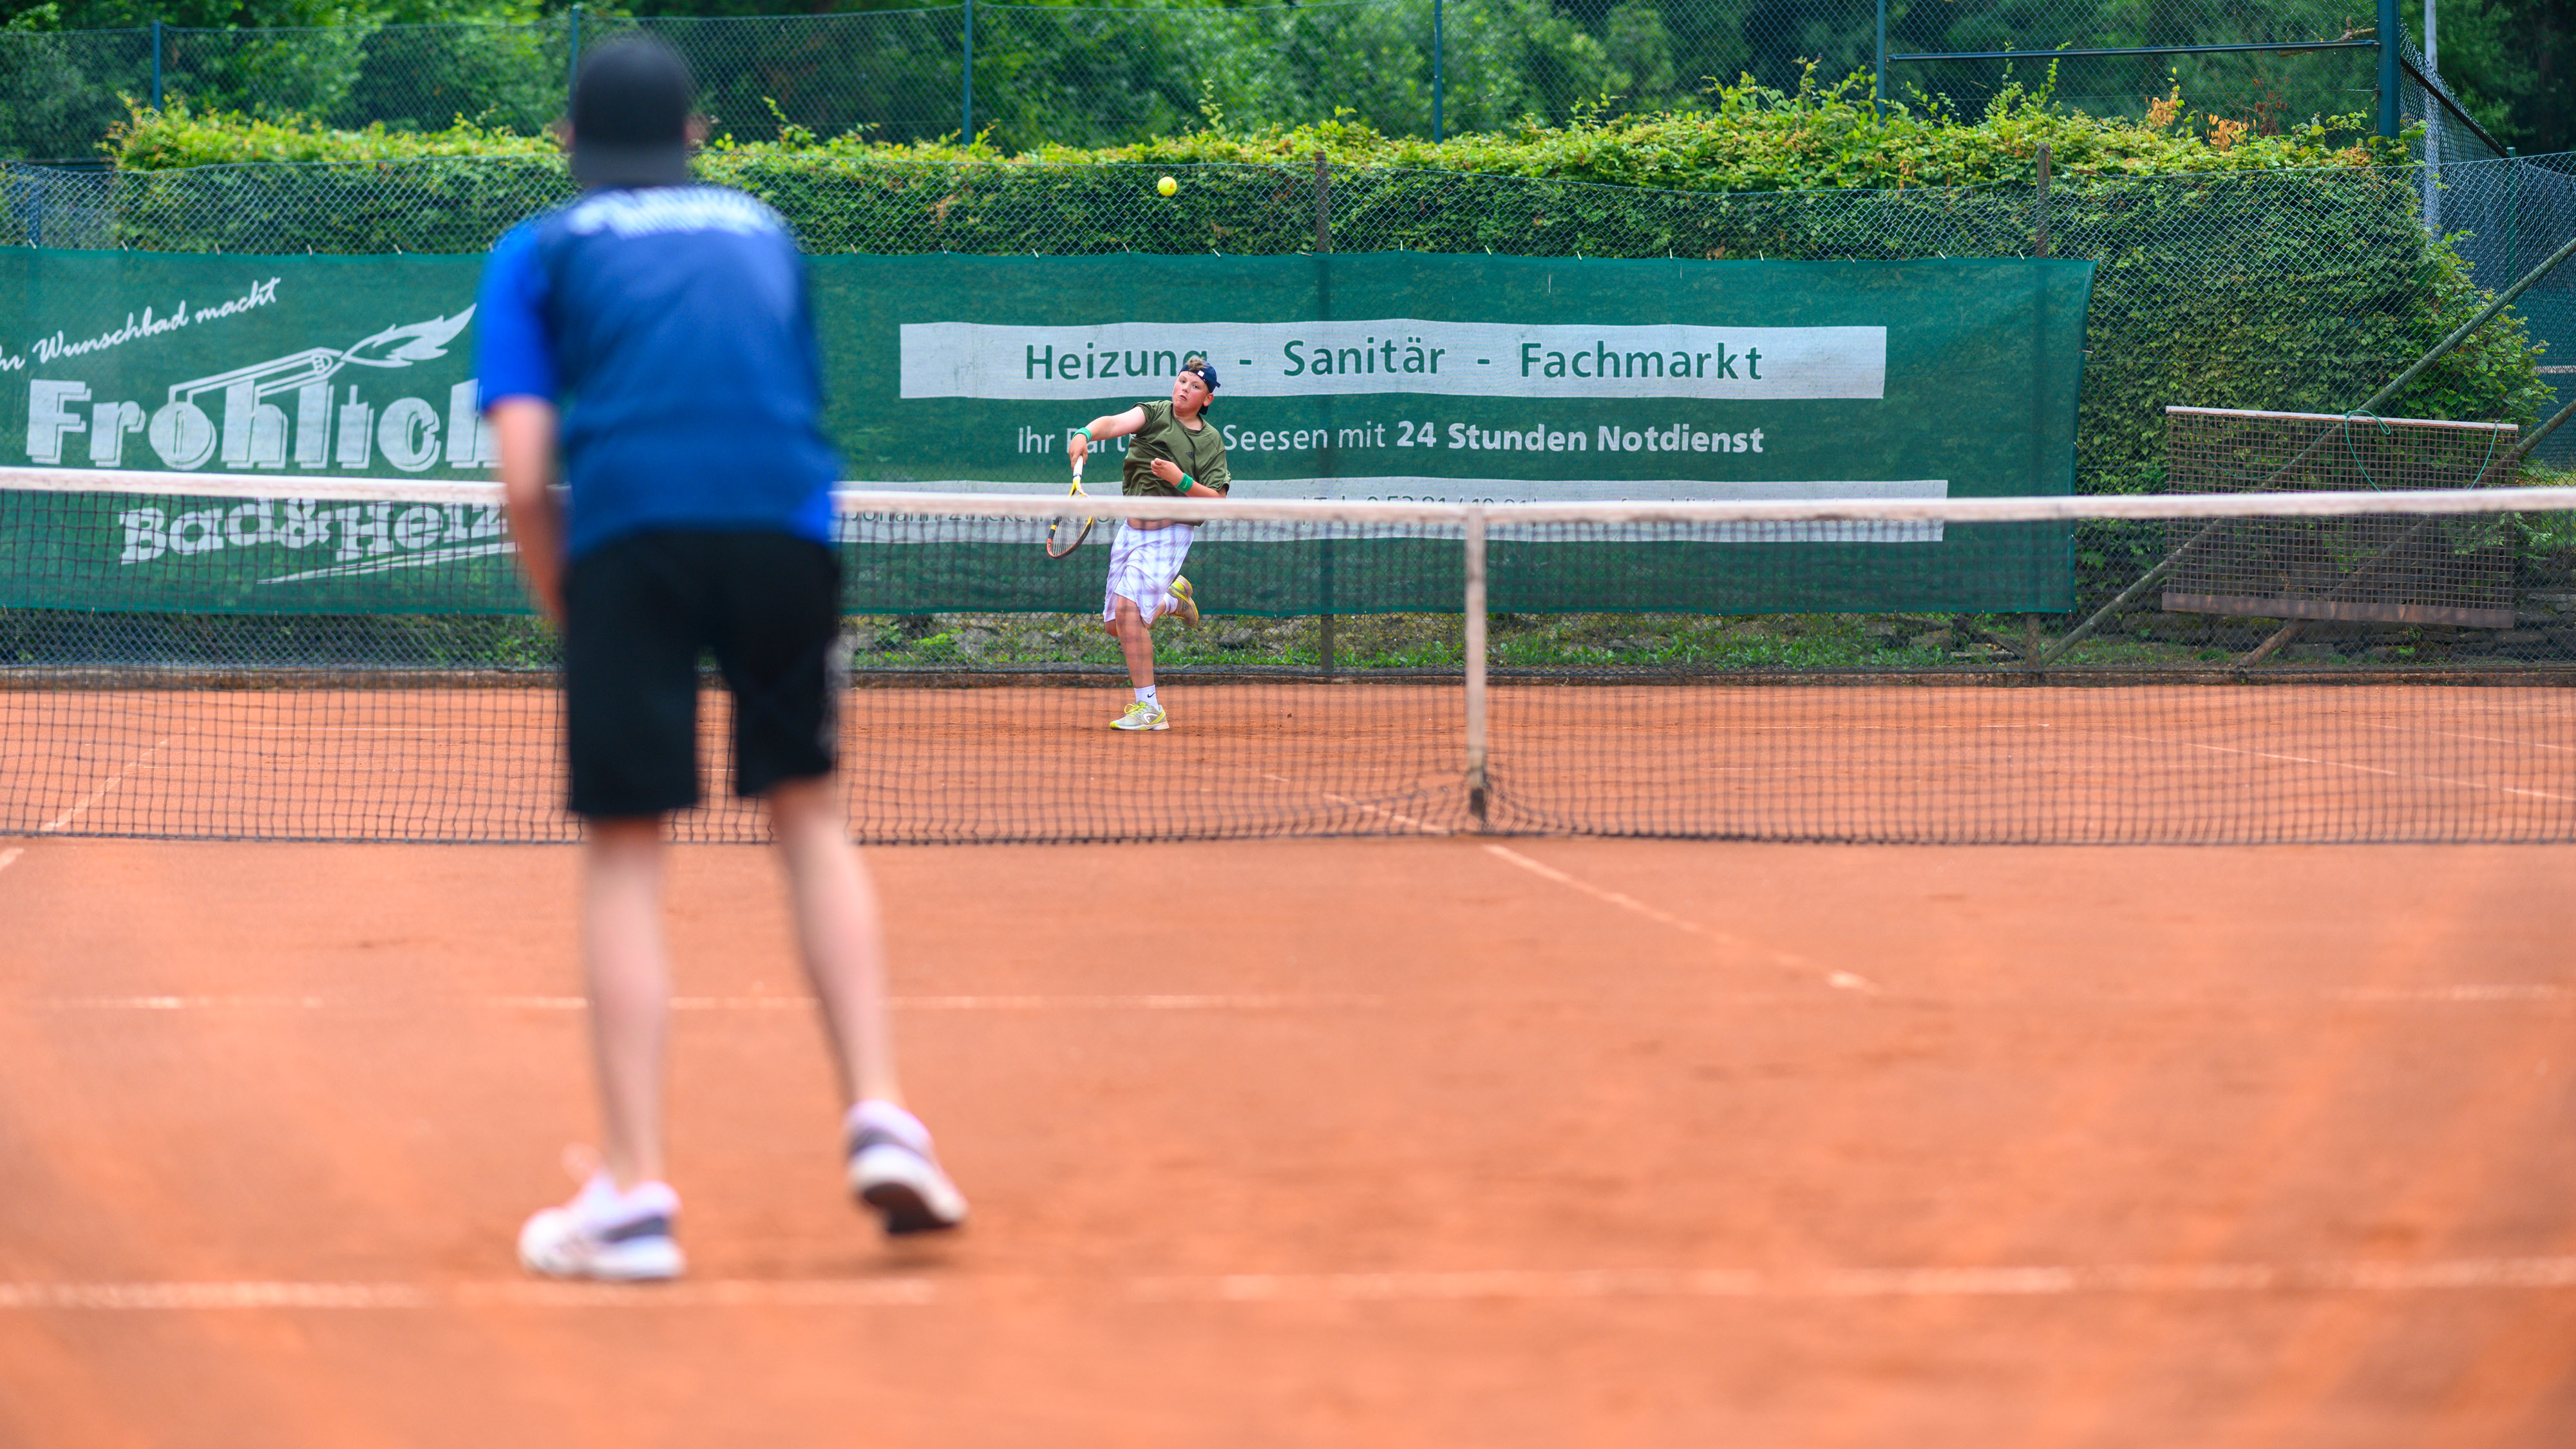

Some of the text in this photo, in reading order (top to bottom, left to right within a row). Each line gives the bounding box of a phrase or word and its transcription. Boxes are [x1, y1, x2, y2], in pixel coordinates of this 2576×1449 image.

[32, 300, 189, 363] Wunschbad
[195, 277, 281, 323] macht
[1283, 337, 1445, 376] Sanitär
[1521, 341, 1763, 379] Fachmarkt
[1018, 426, 1055, 453] Ihr
[1223, 424, 1328, 451] Seesen
[1339, 421, 1385, 448] mit
[1397, 421, 1436, 447] 24
[1448, 423, 1587, 451] Stunden
[1598, 424, 1764, 452] Notdienst
